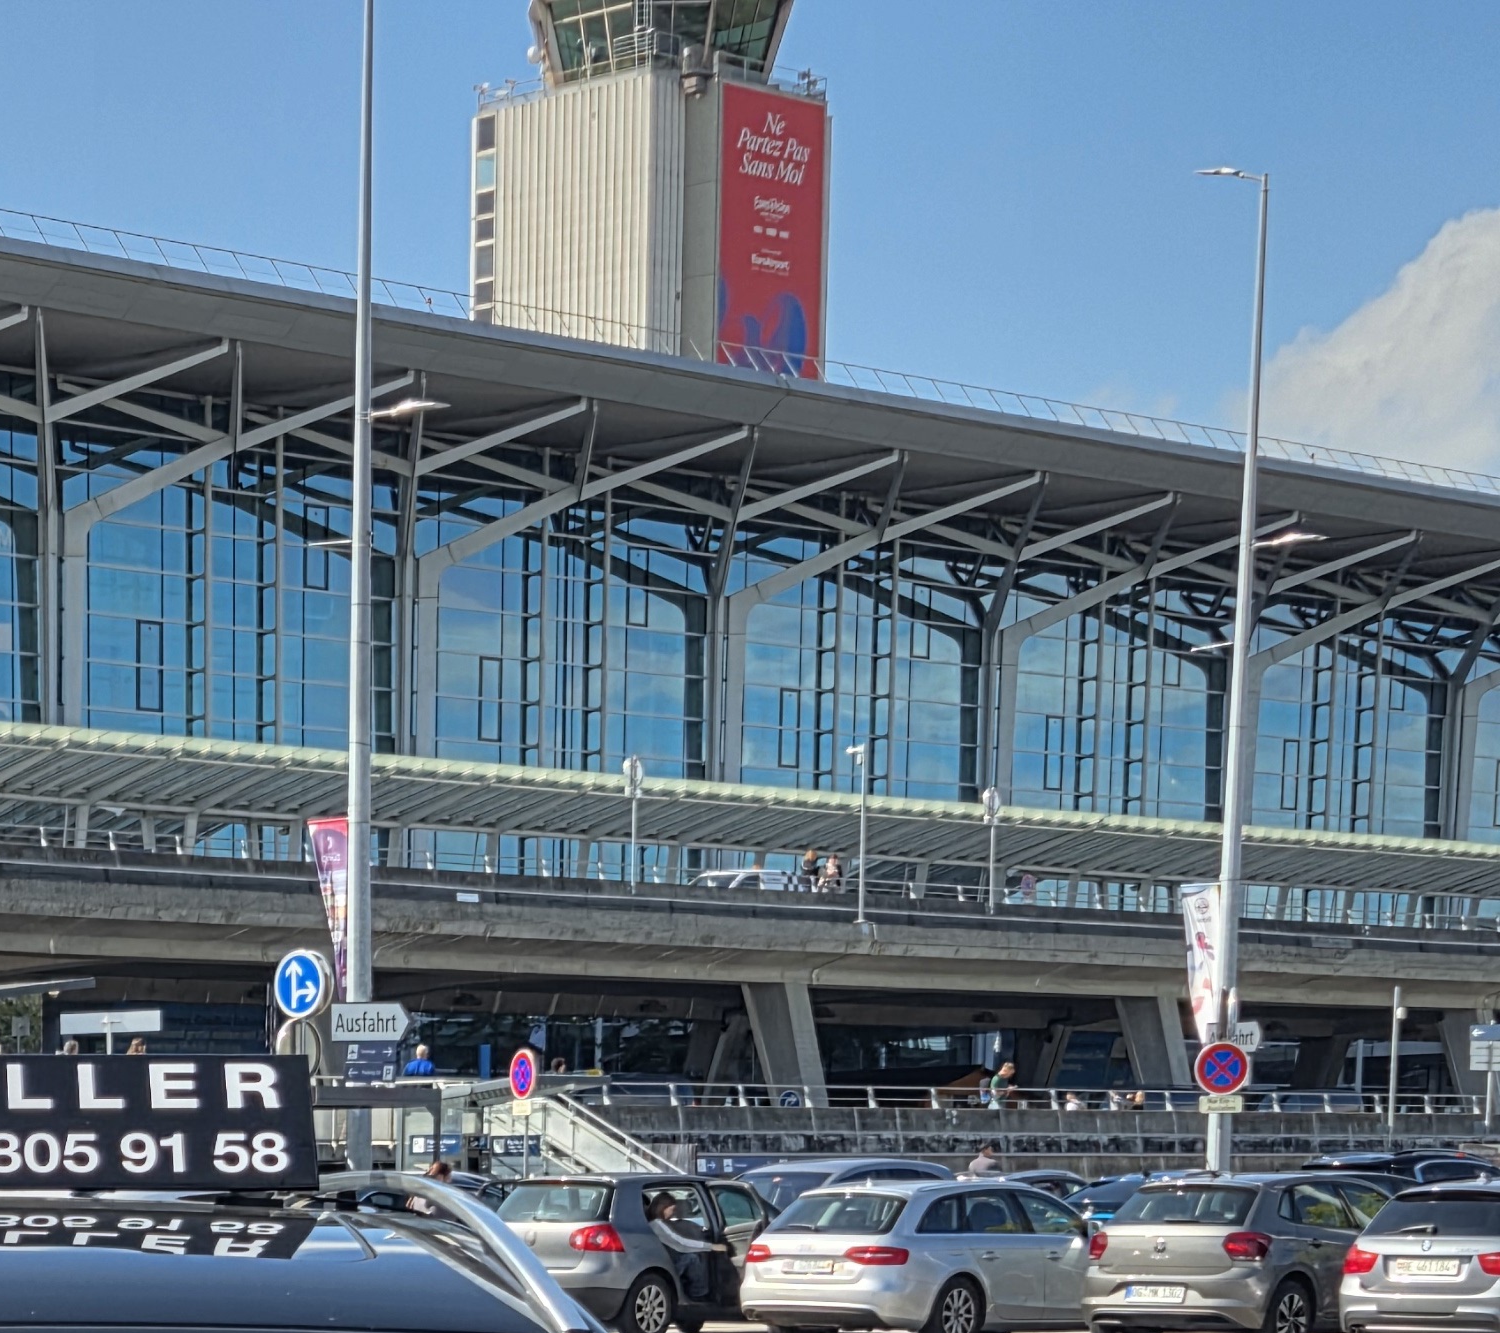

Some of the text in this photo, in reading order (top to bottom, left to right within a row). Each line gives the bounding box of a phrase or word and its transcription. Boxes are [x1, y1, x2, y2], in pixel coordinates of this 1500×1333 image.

[763, 112, 786, 136] Ne
[737, 127, 810, 162] Partez Pas
[739, 151, 775, 178] Sans
[335, 1011, 397, 1034] Ausfahrt
[1210, 1030, 1254, 1046] Aahrt
[119, 1132, 187, 1174] 91
[212, 1132, 288, 1174] 58
